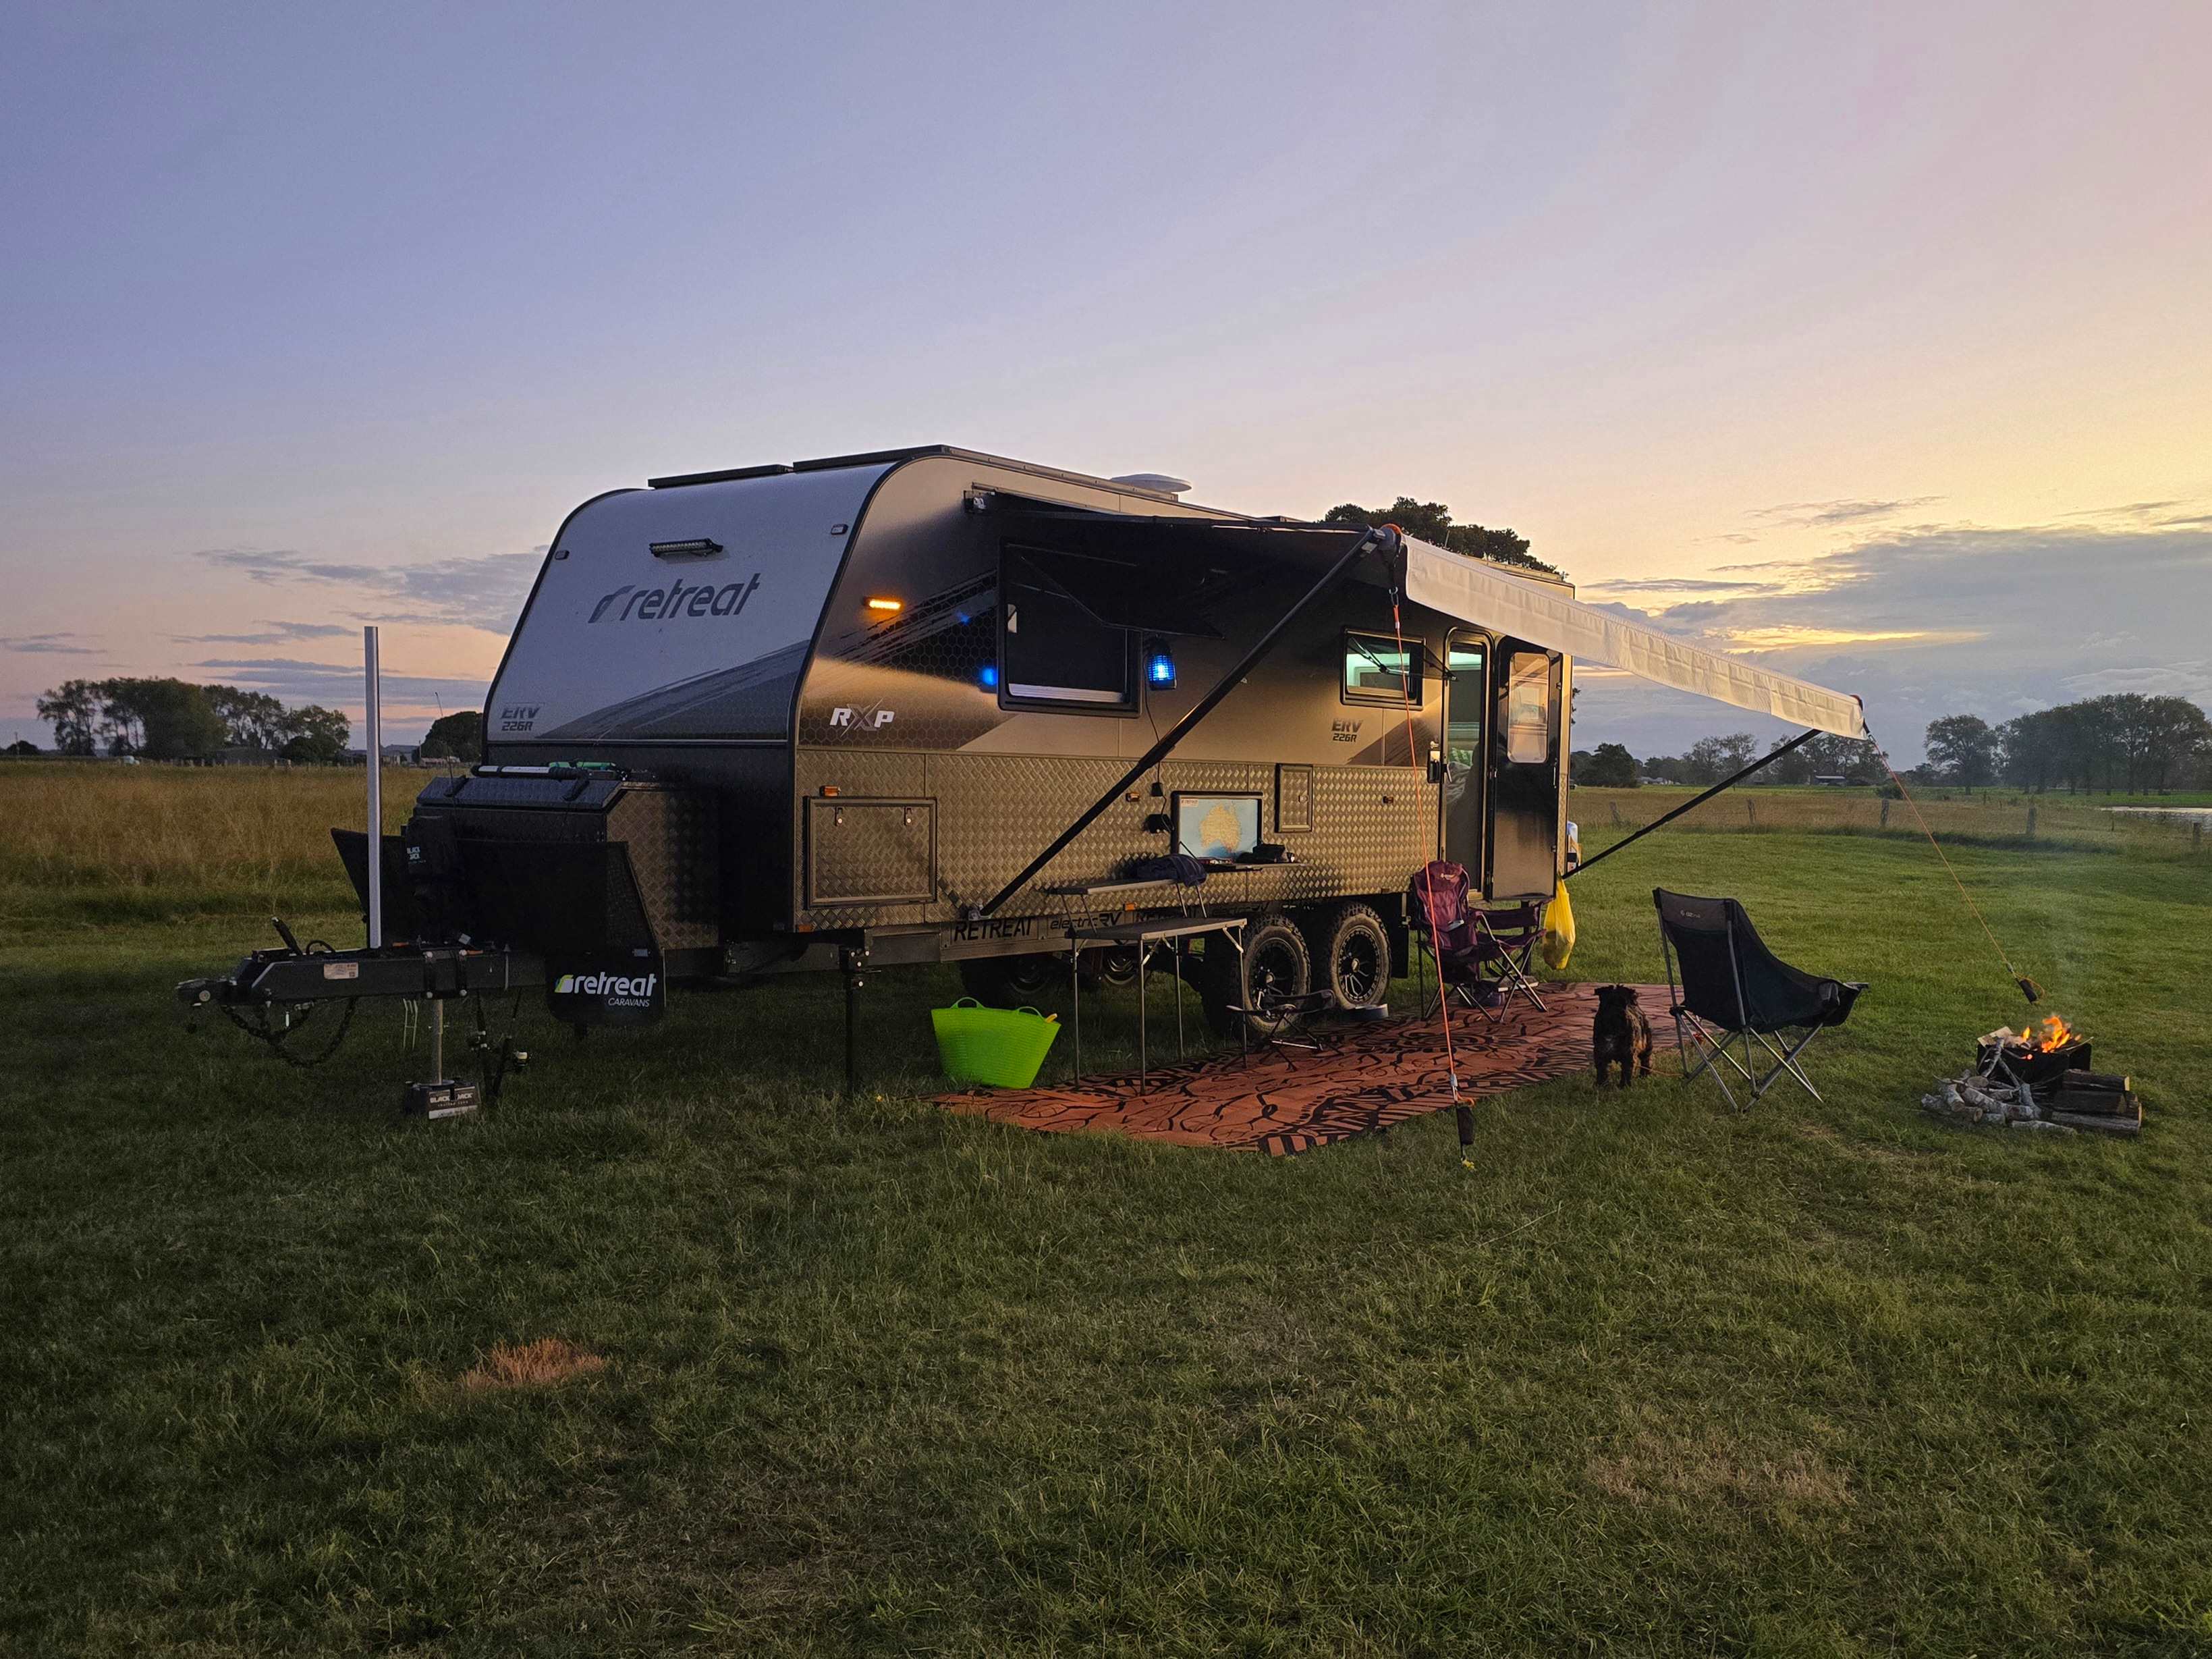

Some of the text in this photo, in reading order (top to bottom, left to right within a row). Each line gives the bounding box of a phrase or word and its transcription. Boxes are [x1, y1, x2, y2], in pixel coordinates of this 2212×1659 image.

[619, 572, 761, 621] retreat
[501, 721, 533, 732] 226R
[829, 699, 895, 736] RXP
[1333, 733, 1357, 743] 226R
[954, 917, 1031, 942] RETREAT
[574, 971, 657, 997] retreat
[608, 998, 650, 1008] CARAVANS
